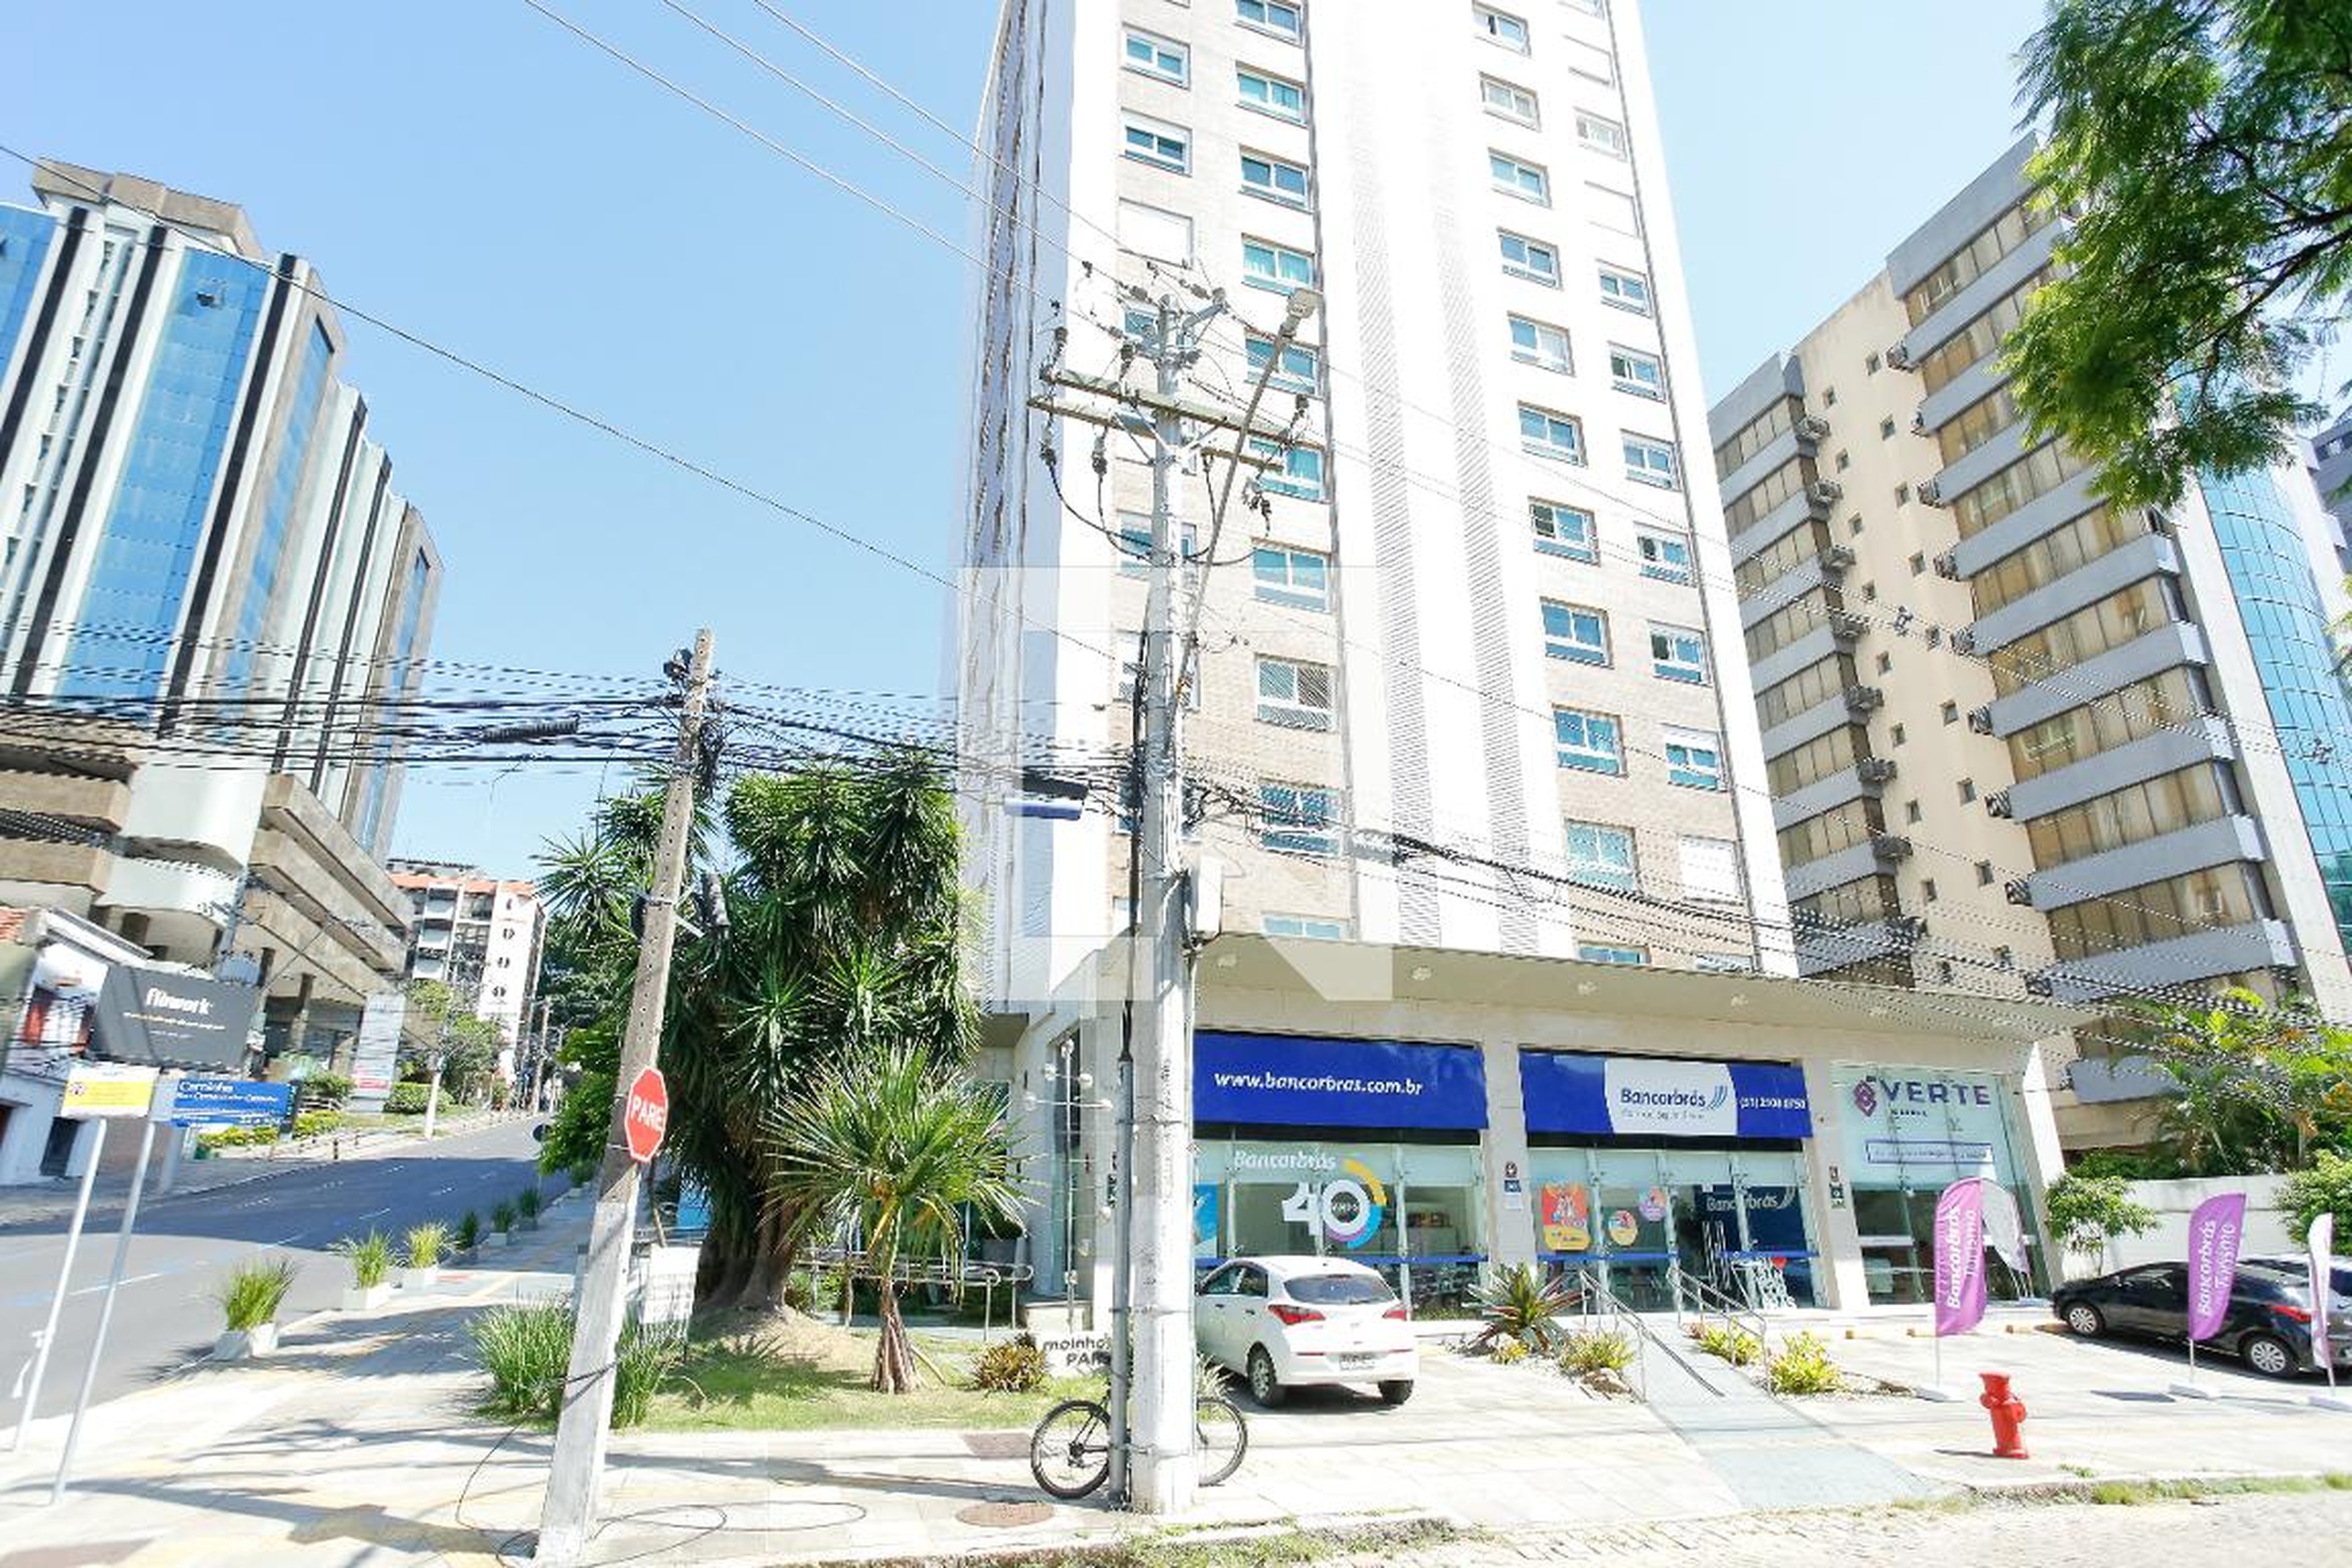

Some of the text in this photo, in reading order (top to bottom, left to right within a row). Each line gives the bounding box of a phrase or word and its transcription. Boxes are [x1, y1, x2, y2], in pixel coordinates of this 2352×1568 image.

[1214, 1071, 1423, 1095] www.bancorbras.com.br
[1880, 1077, 1991, 1106] VERTE
[1621, 1087, 1706, 1108] Bancorbrás
[630, 1095, 664, 1131] PARE
